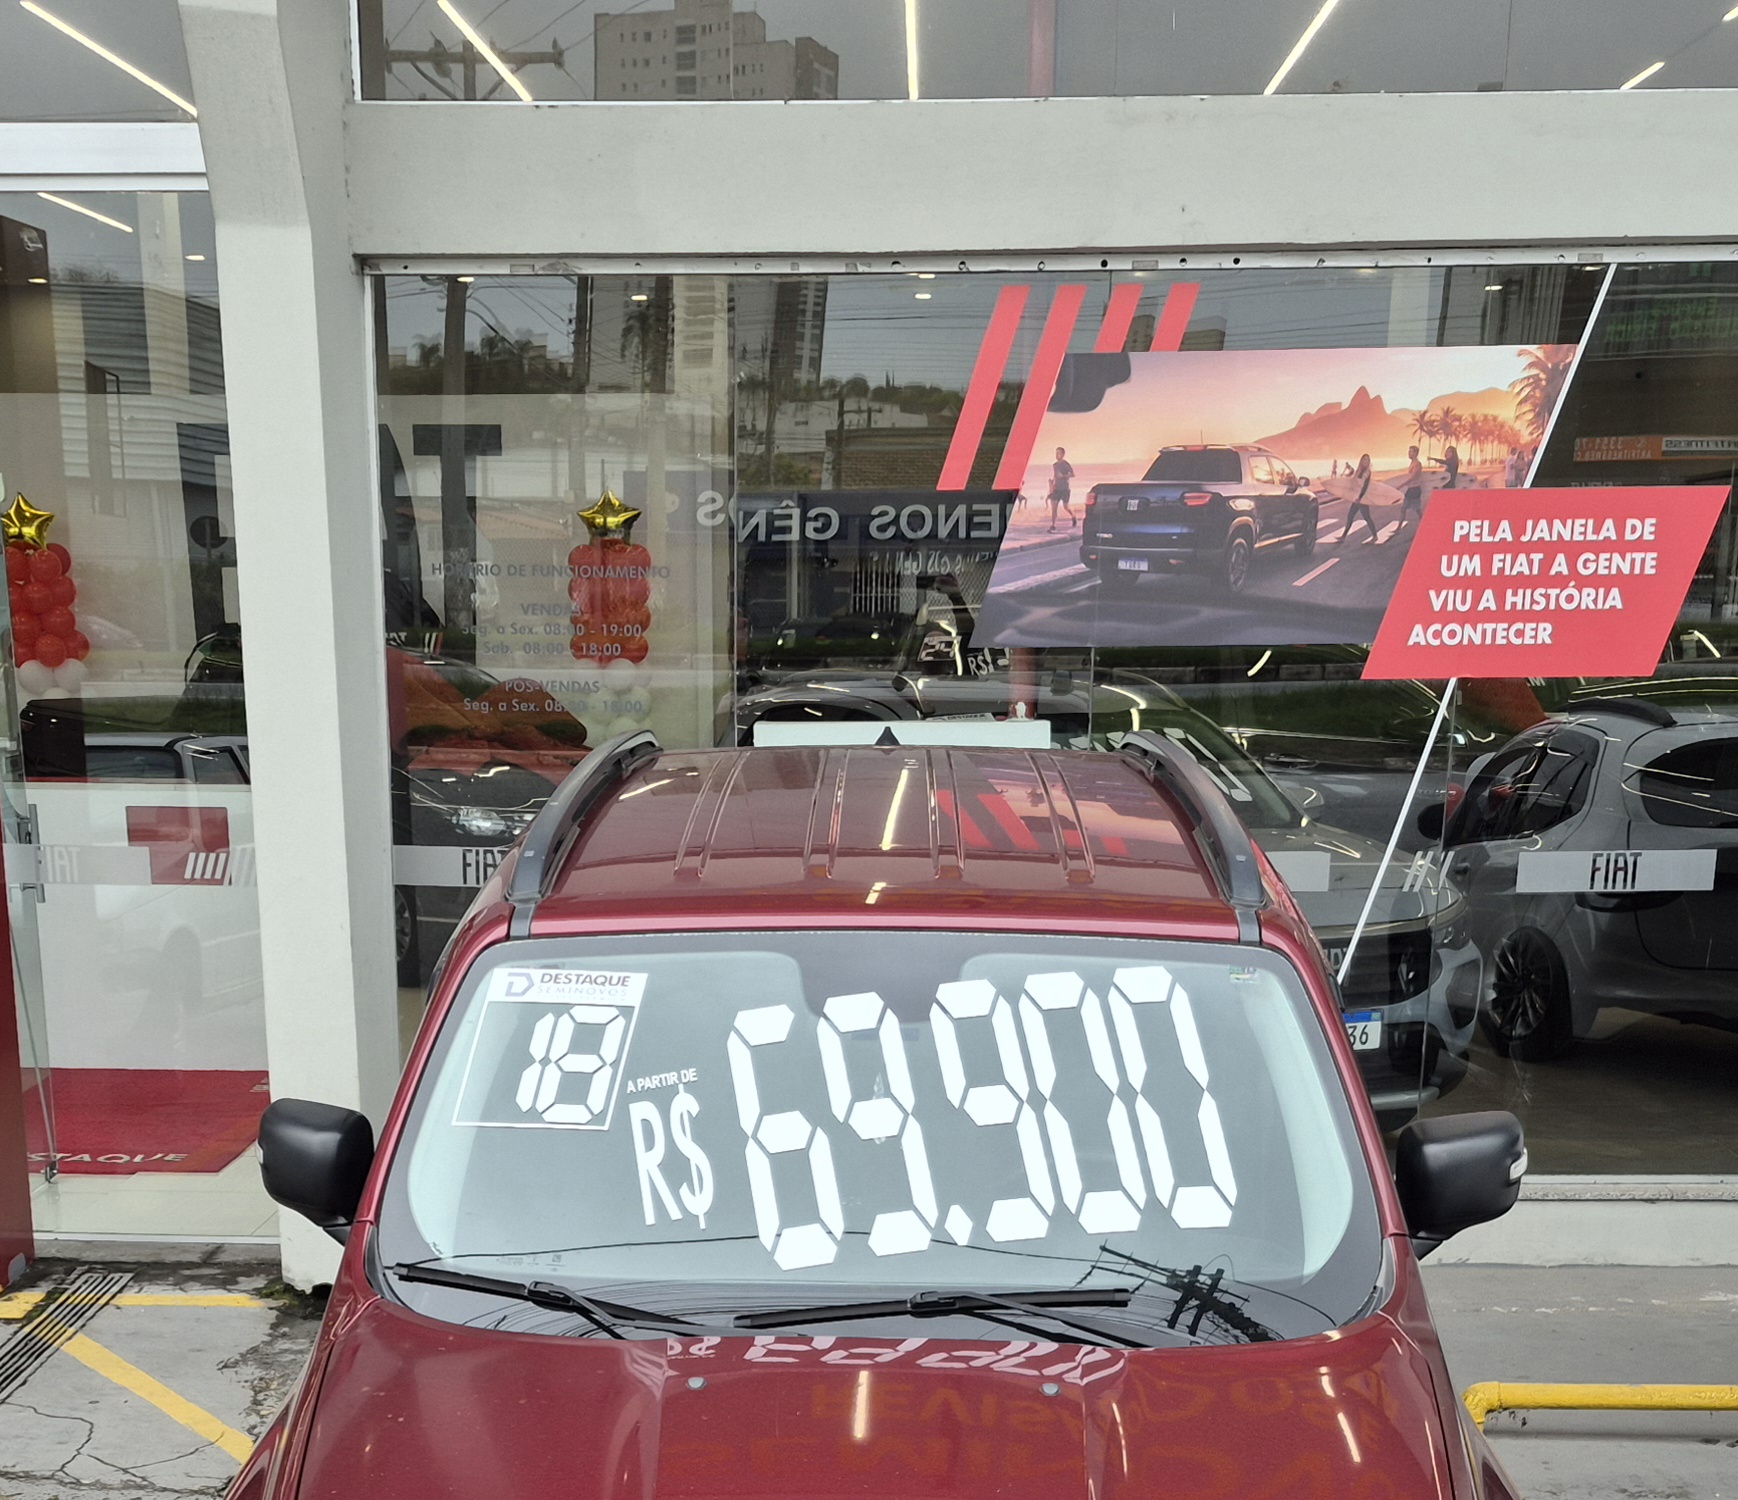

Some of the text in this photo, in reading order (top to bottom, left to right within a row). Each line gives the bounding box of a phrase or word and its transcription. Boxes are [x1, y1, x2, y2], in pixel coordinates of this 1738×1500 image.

[1453, 517, 1657, 542] PELA JANELA DE
[507, 564, 526, 577] DE
[532, 564, 671, 579] FUNCIONAMENTO
[1440, 552, 1658, 577] UM FIAT A GENTE
[1429, 581, 1623, 612] VIU A HISTÓRIA
[498, 626, 506, 635] a
[510, 622, 539, 635] Sex.
[602, 624, 642, 637] 19:00
[1407, 623, 1553, 646] ACONTECER
[580, 643, 621, 656] 18:00
[463, 698, 494, 713] Seg.
[498, 701, 507, 712] a
[511, 699, 541, 712] Sex.
[1589, 852, 1643, 890] FIAT
[538, 986, 628, 997] SEMINOVOS
[540, 973, 631, 987] DESTAQUE
[515, 1005, 627, 1124] 18
[627, 1067, 699, 1094] A PARTIR DE
[629, 965, 1238, 1271] R$ 69.900
